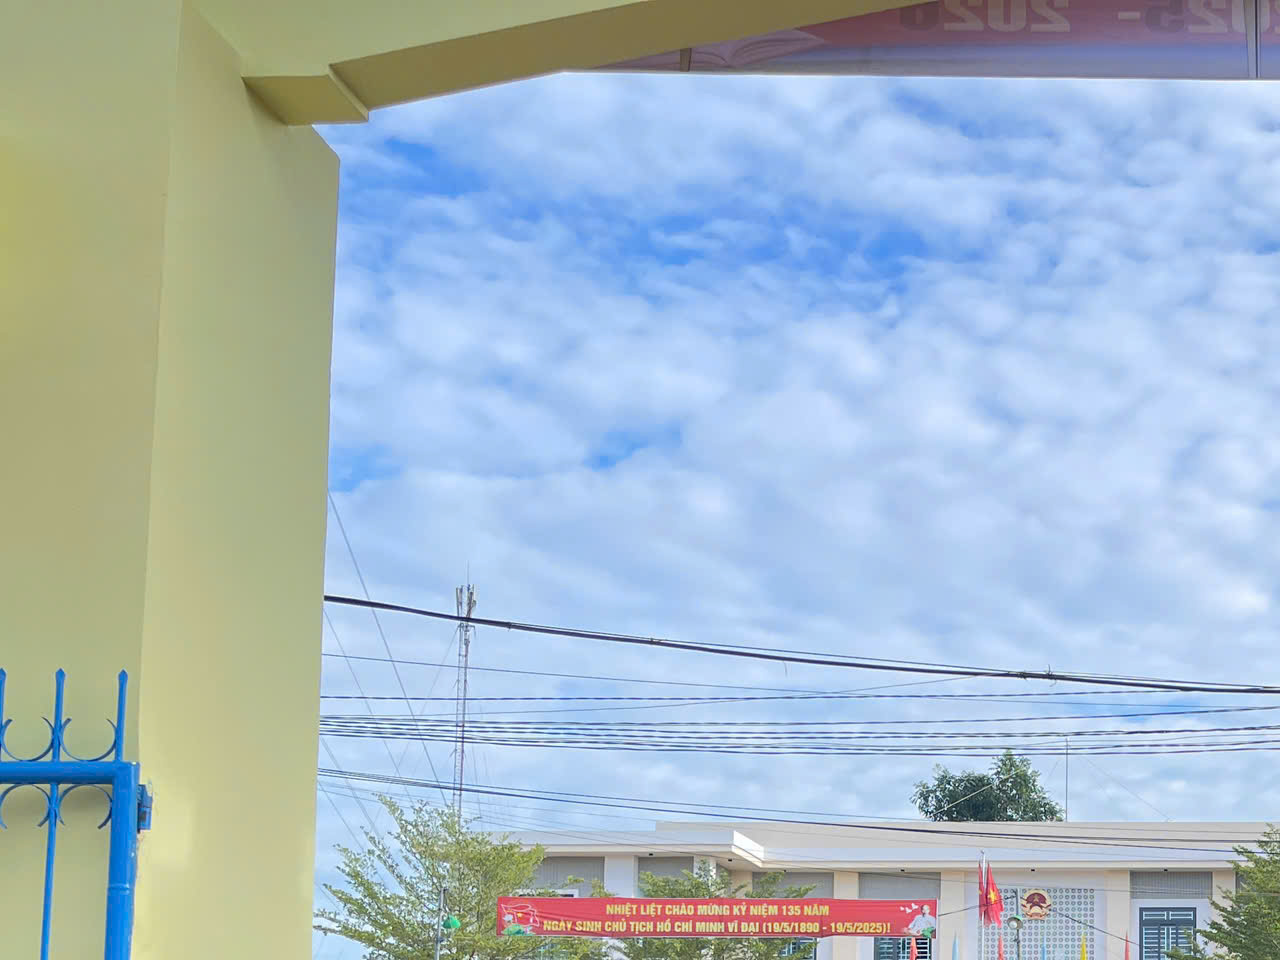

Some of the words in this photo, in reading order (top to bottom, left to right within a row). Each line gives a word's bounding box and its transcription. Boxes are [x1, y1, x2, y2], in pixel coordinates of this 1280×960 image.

[605, 903, 638, 917] NHIỆT
[640, 903, 663, 917] LIỆT
[665, 903, 695, 916] CHÀO
[750, 903, 779, 918] NIỆM
[782, 905, 801, 916] 135
[803, 903, 830, 916] NĂM
[575, 920, 602, 932] SINH
[604, 919, 627, 932] CHỦ
[629, 921, 653, 934] TỊCH
[674, 920, 693, 932] CHÍ
[695, 921, 724, 933] MINH
[727, 920, 739, 933] VĨ
[741, 922, 759, 935] ĐẠI
[762, 922, 820, 933] (19/5/1890
